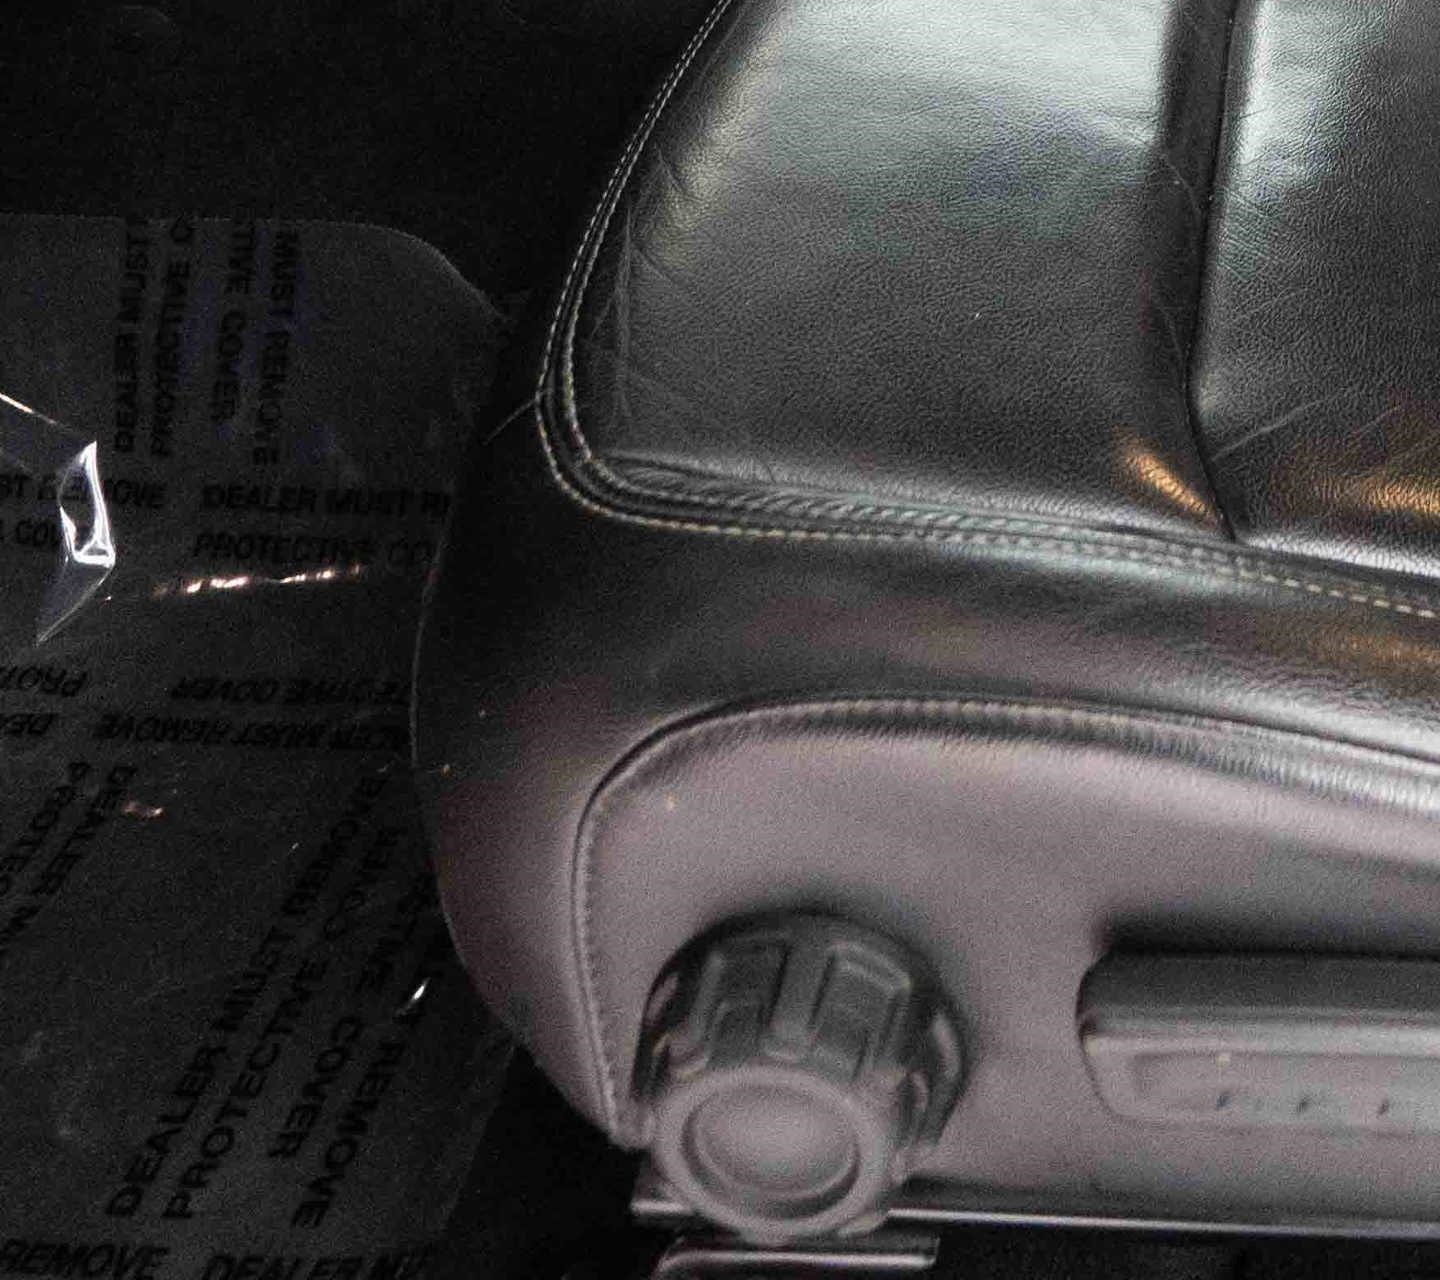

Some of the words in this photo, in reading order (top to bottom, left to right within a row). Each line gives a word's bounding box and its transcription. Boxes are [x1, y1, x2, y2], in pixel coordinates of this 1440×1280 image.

[104, 1045, 229, 1218] DEALER
[160, 958, 330, 1220] PROTECTIVE
[267, 1015, 363, 1161] COVER
[290, 1042, 408, 1229] REMOVE
